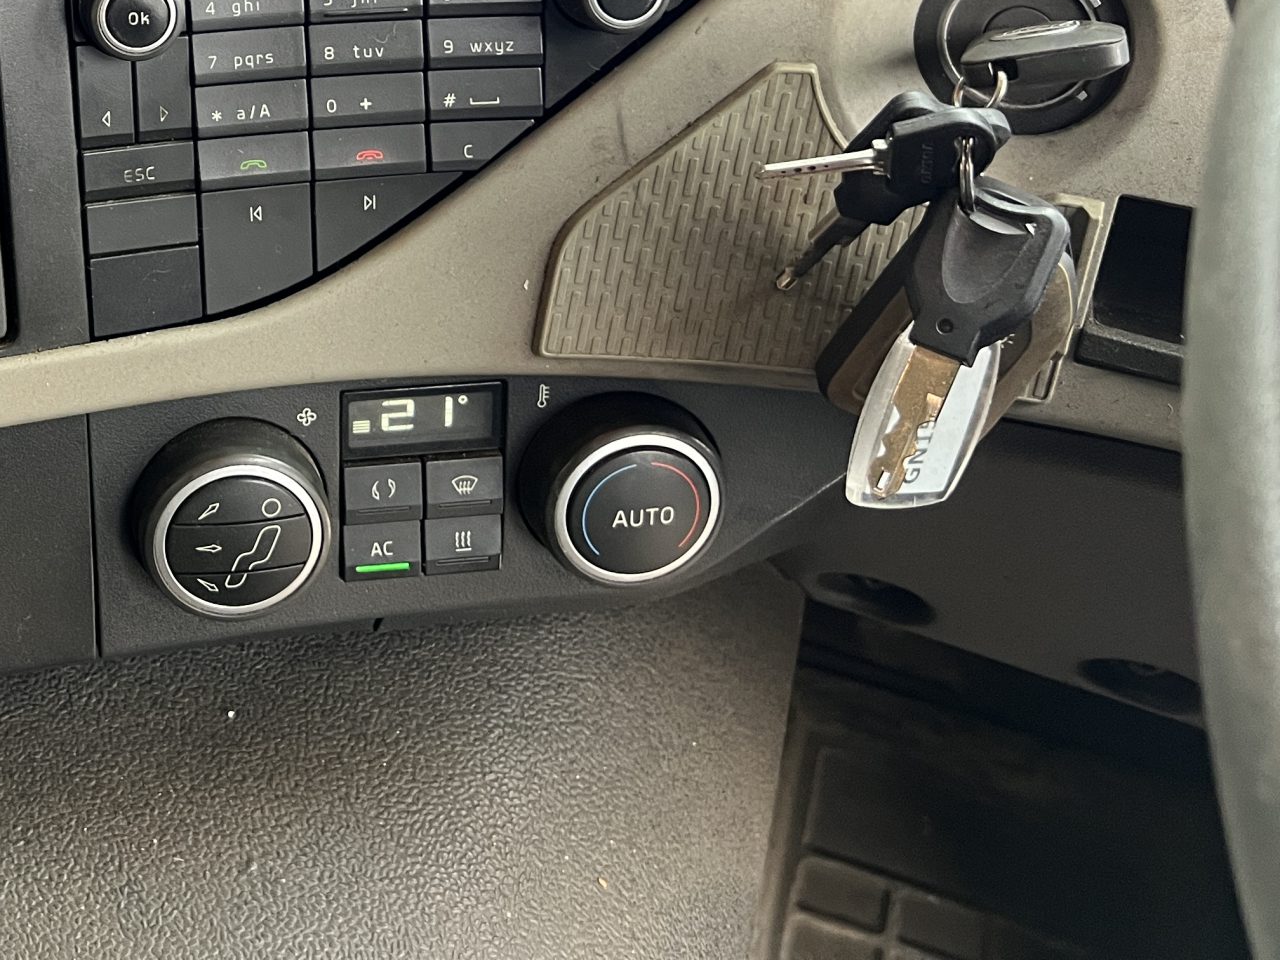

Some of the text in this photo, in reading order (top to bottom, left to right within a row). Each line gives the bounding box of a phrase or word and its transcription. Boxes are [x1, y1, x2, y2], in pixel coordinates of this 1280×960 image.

[206, 0, 259, 16] 4 ghi
[129, 12, 149, 25] Ok
[325, 45, 383, 60] 8 tuv
[444, 40, 513, 55] 9 wxyz
[208, 53, 273, 69] 7 pqrs
[443, 93, 456, 107] #
[237, 104, 270, 120] a/A
[464, 145, 473, 158] C
[124, 166, 155, 182] ESC
[612, 507, 674, 528] AUTO
[371, 541, 393, 557] AC
